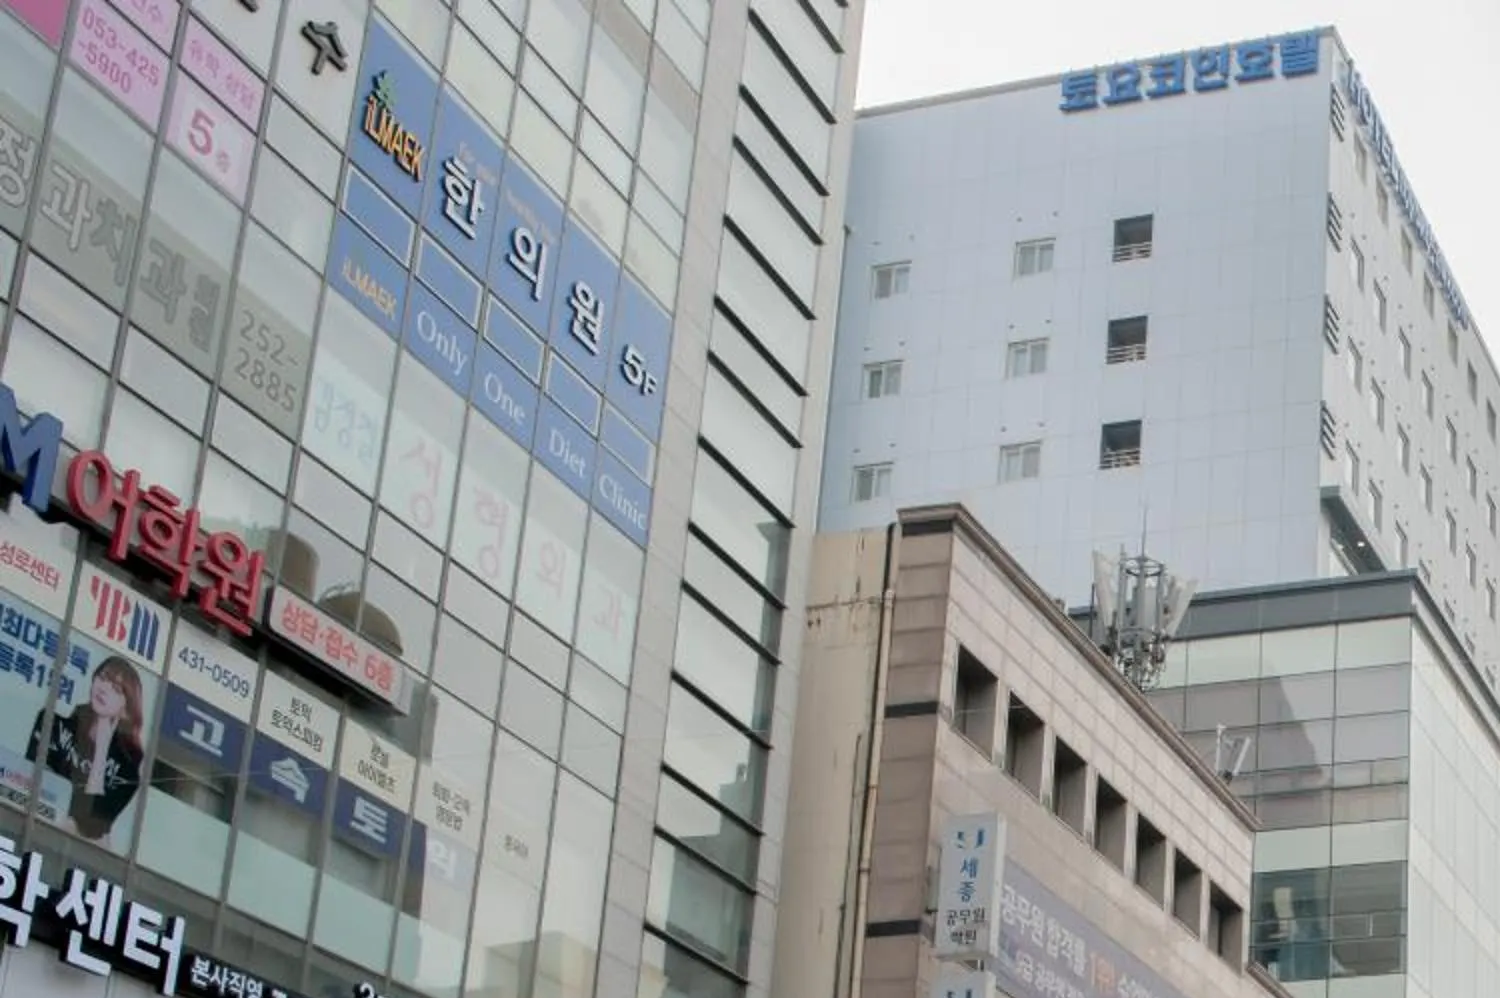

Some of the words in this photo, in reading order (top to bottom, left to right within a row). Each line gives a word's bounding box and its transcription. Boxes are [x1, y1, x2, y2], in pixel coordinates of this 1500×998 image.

[1059, 33, 1319, 113] 토요코인호텔
[441, 157, 606, 355] 한의원
[621, 344, 657, 396] 5F
[235, 350, 297, 412] 2885
[417, 310, 468, 376] Only
[483, 370, 526, 424] One
[549, 429, 588, 478] Diet
[600, 474, 648, 531] Clinic
[67, 449, 266, 638] 어학원
[177, 645, 250, 701] 431-0509
[960, 858, 979, 903] 세종
[945, 907, 986, 927] 공무원
